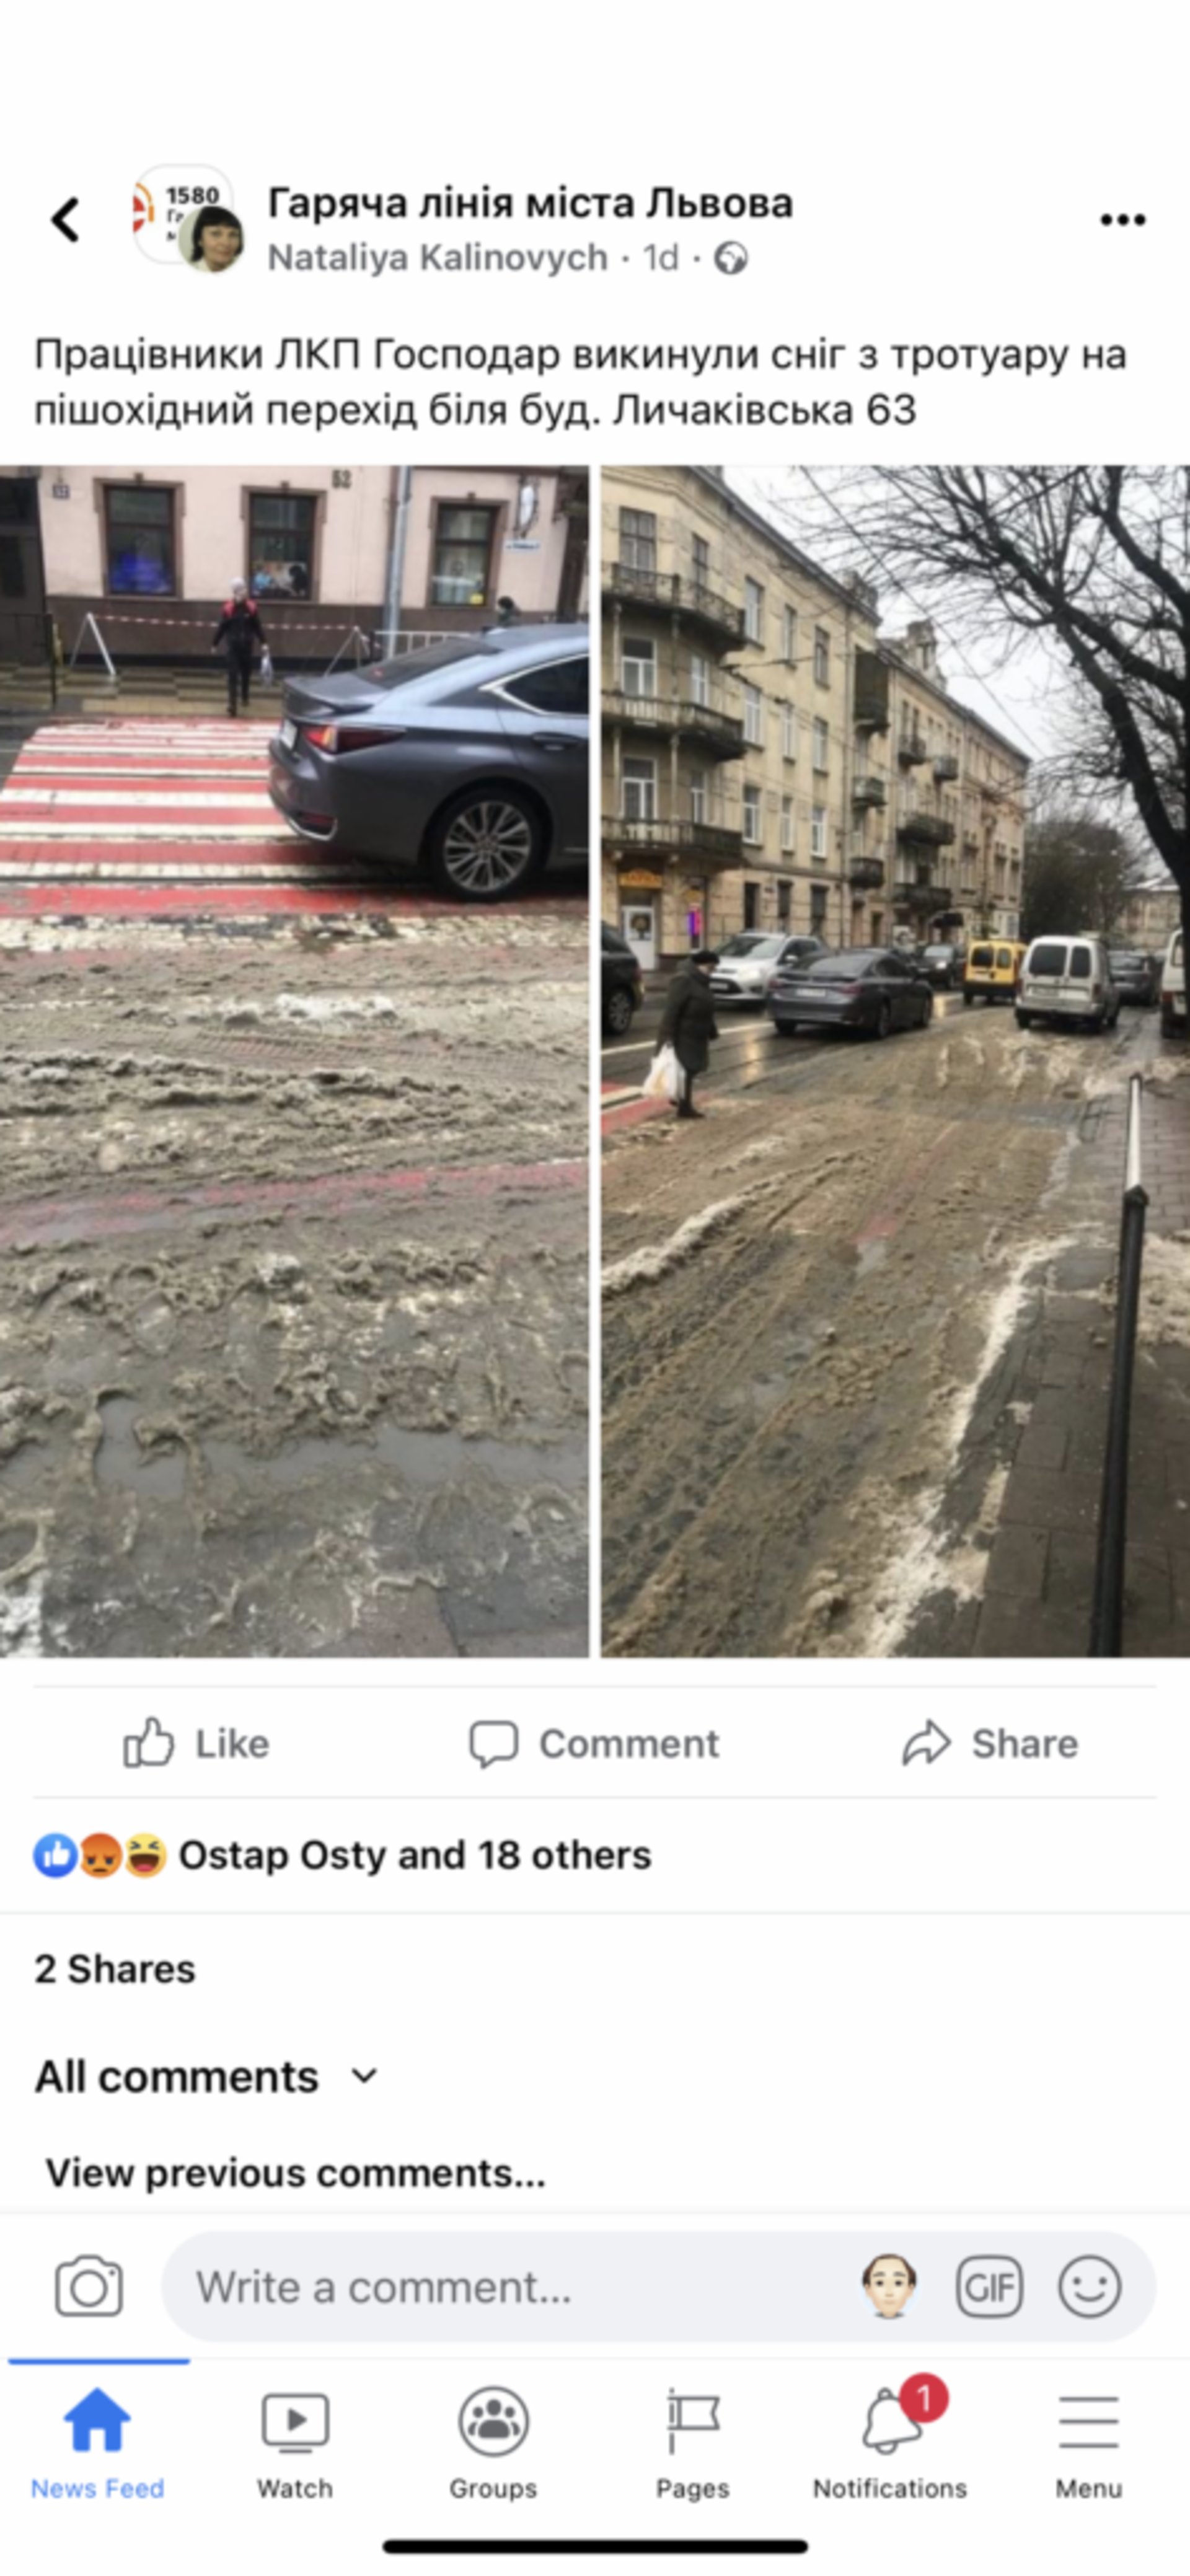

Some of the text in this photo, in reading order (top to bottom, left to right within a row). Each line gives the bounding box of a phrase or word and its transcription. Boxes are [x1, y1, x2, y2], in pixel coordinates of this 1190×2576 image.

[166, 187, 219, 204] 1580
[270, 184, 793, 226] Гаряча лінія міста Львова
[270, 242, 678, 277] Nataliya Kalinovych 1d
[36, 336, 1126, 377] Працівники ЛКП Господар викинули сніг з тротуару на
[35, 392, 916, 433] пішохідний перехід біля буд. Личаківська 63
[197, 1727, 269, 1759] Like
[540, 1728, 719, 1759] Comment
[974, 1728, 1078, 1759] Share
[179, 1839, 652, 1877] Ostap Osty and 18 others
[35, 1953, 196, 1984] 2 Shares
[35, 2058, 319, 2093] All comments
[45, 2156, 545, 2194] View previous comments...
[196, 2269, 570, 2303] Write a comment...
[965, 2274, 1015, 2302] GIF
[917, 2384, 930, 2412] 1
[32, 2479, 164, 2499] News Feed
[257, 2478, 332, 2499] Watch
[450, 2478, 537, 2503] Groups
[657, 2478, 729, 2503] Pages
[814, 2477, 967, 2499] Notifications
[1056, 2479, 1122, 2499] Menu
